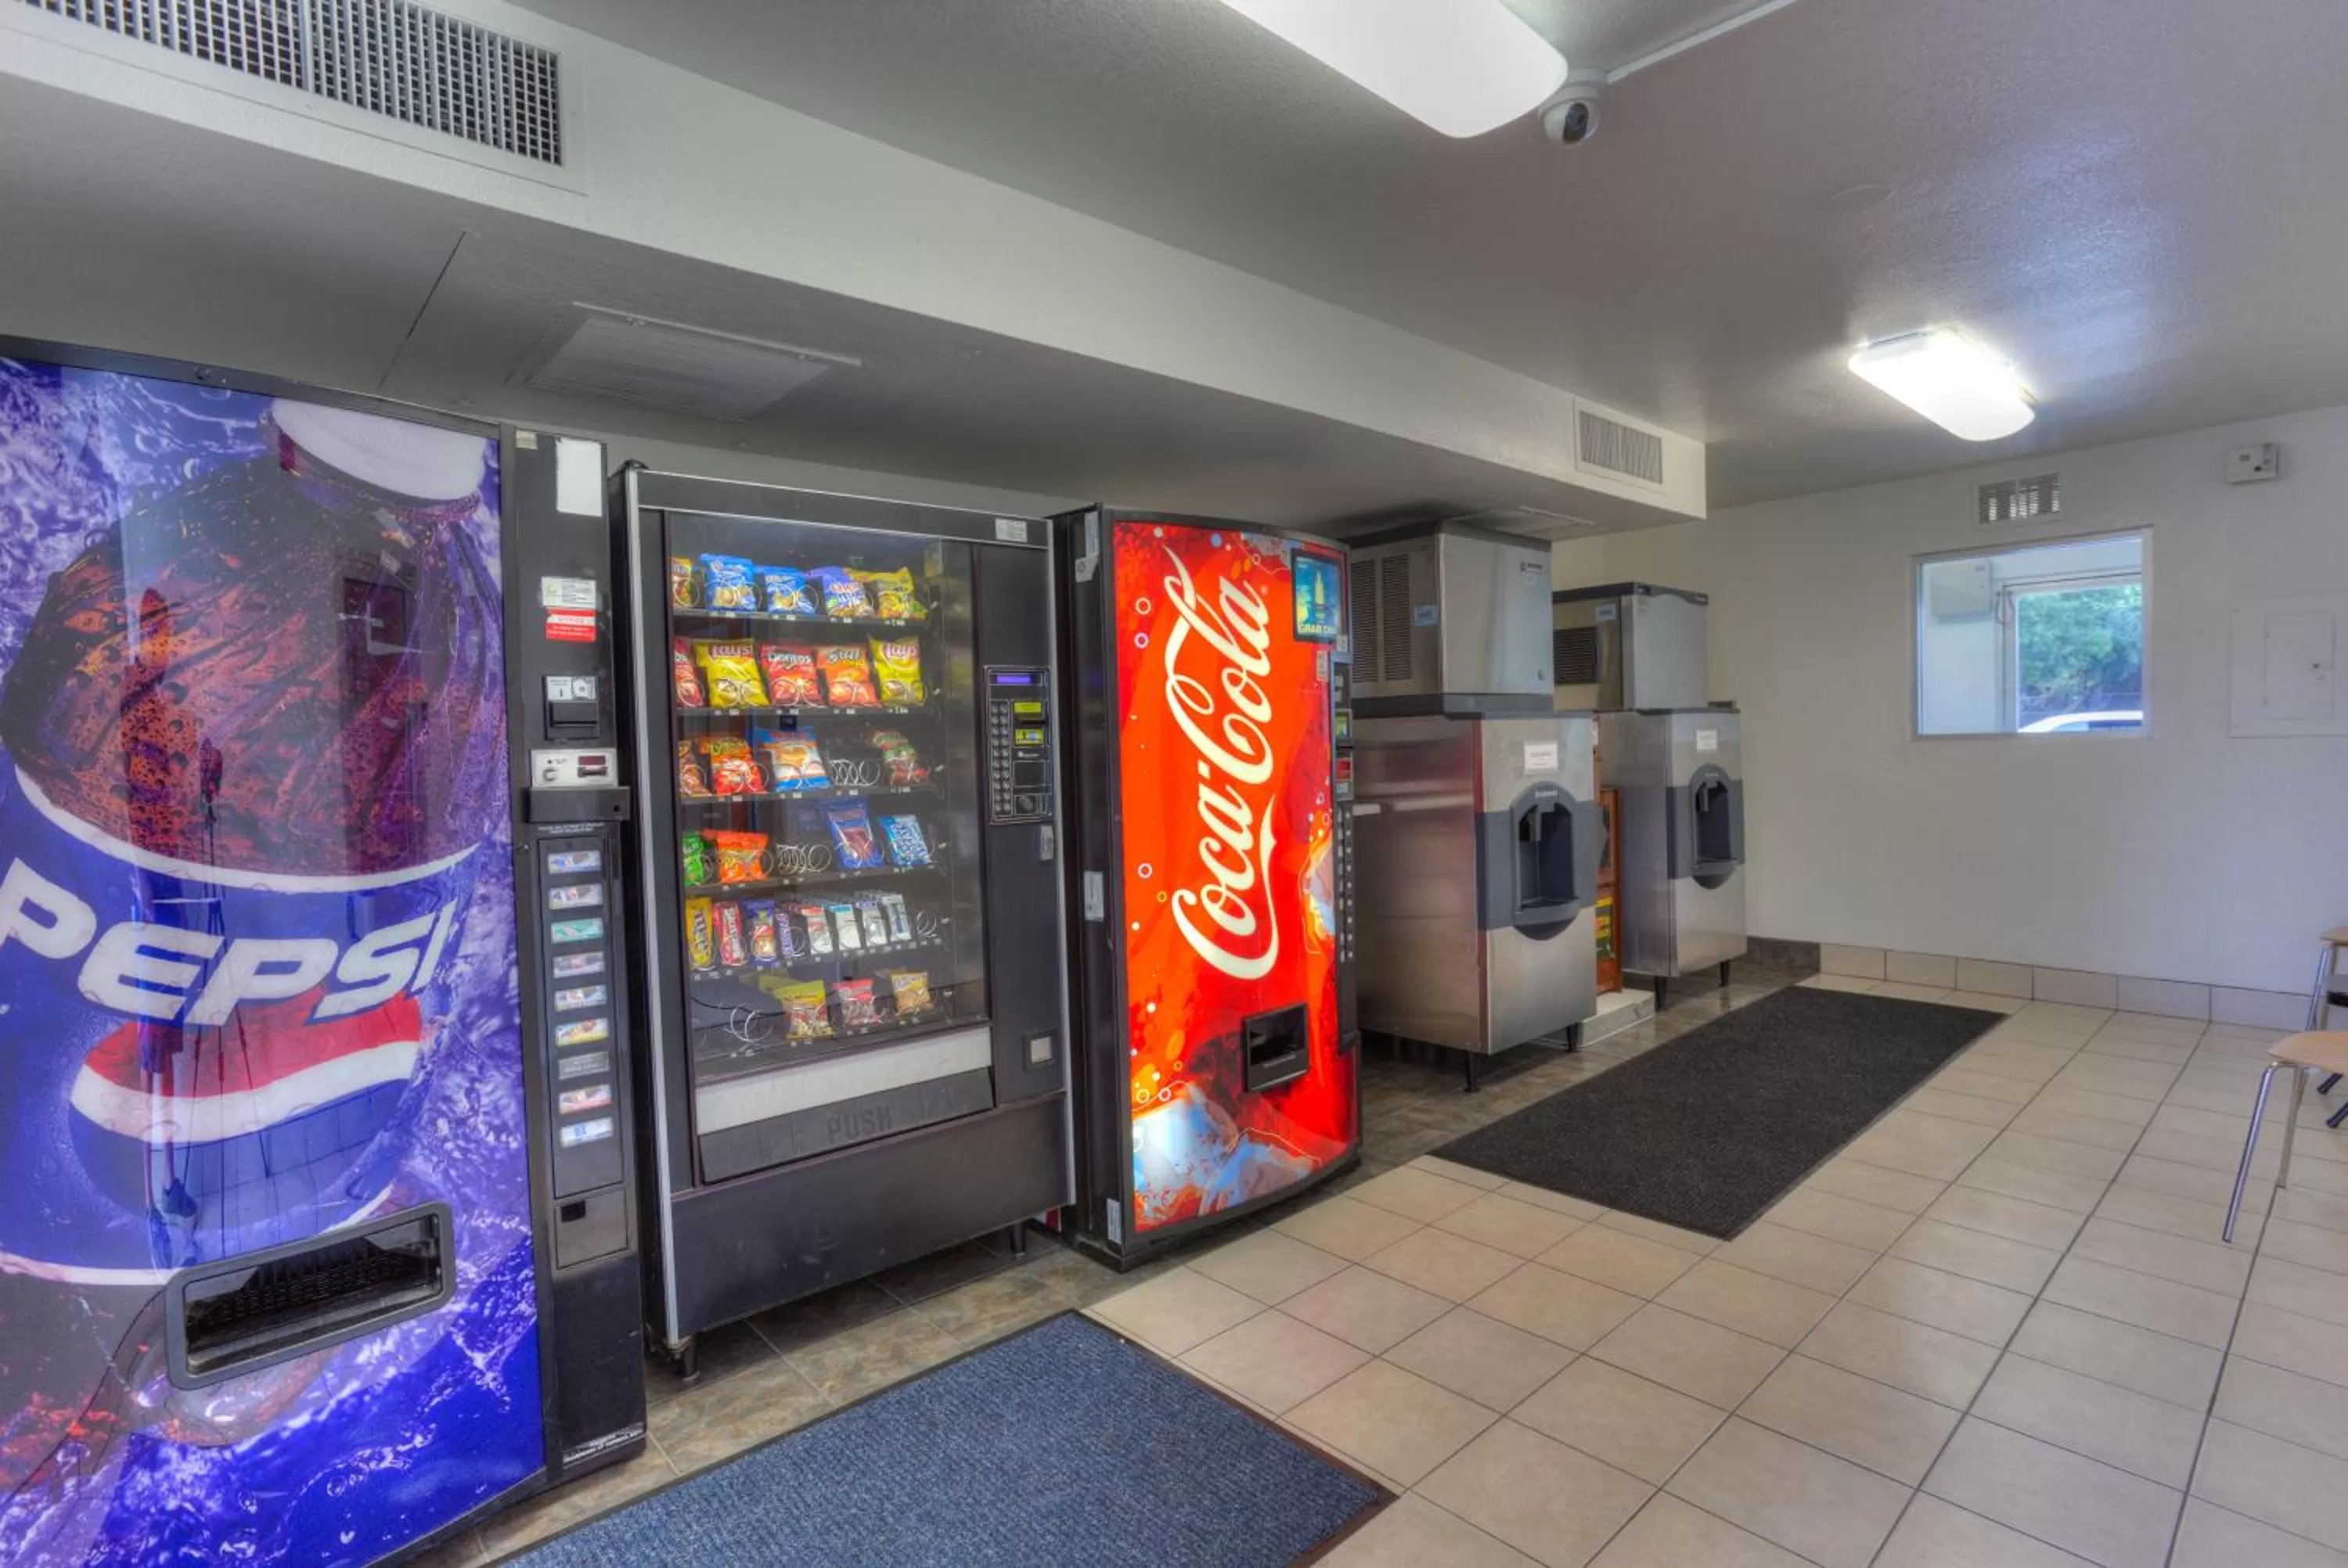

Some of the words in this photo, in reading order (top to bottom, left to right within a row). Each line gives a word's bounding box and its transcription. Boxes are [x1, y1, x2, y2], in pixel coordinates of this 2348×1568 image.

[1164, 545, 1280, 980] Coca-Cola
[0, 857, 457, 1027] PEPSI
[826, 1105, 892, 1144] PUSH
